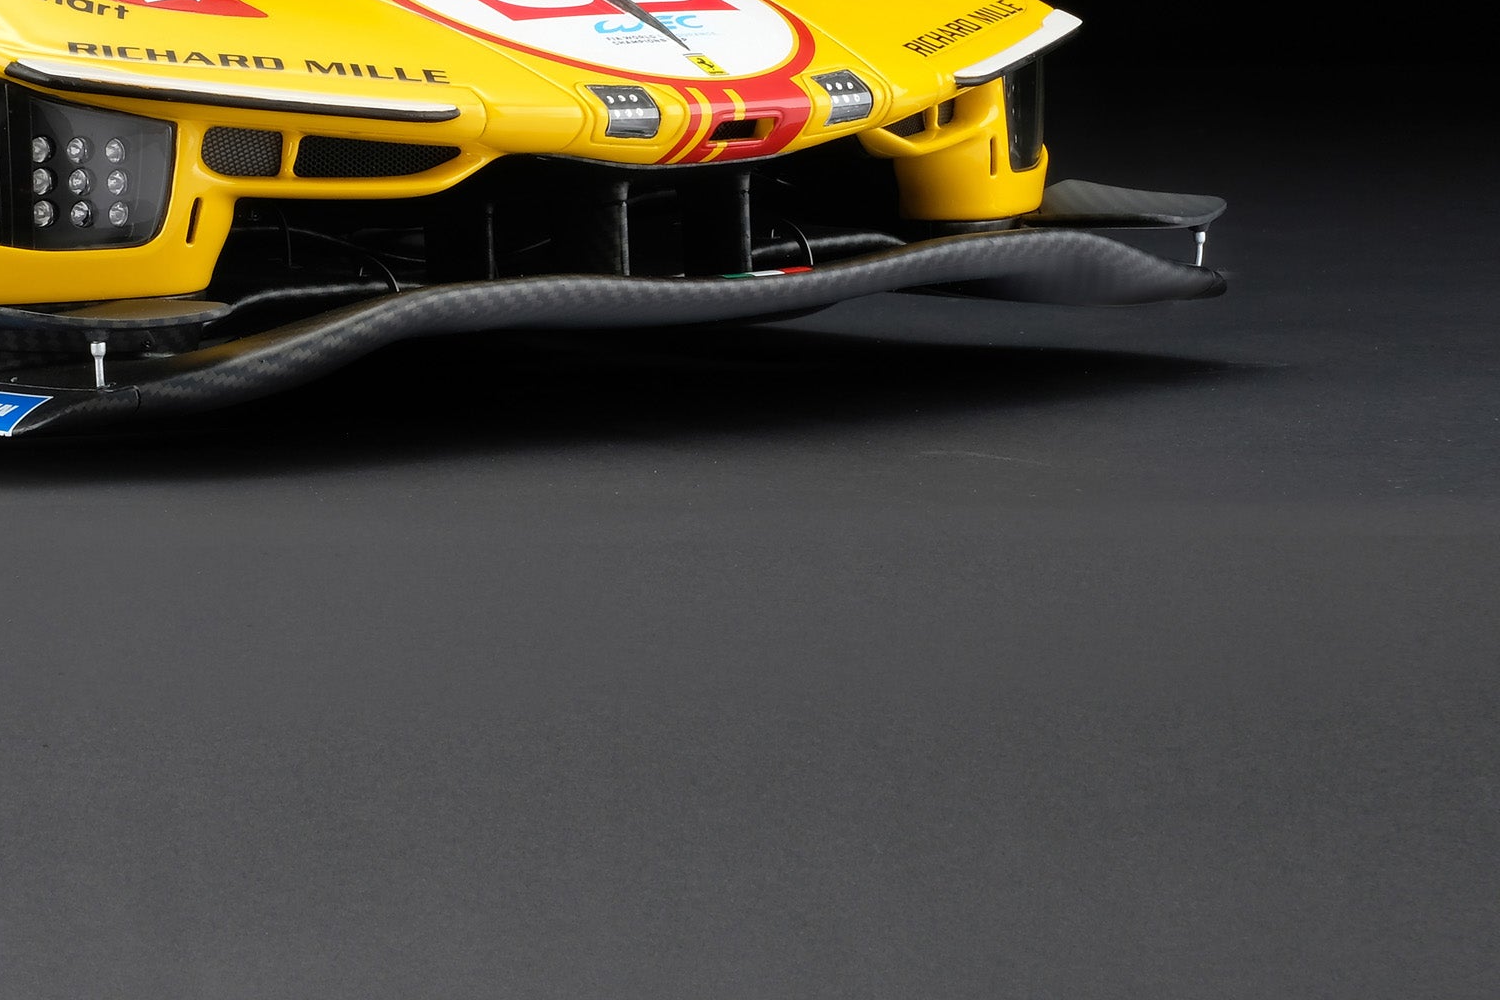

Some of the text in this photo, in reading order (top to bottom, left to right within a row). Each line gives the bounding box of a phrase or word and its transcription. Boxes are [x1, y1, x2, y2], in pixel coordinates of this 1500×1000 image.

[902, 0, 1023, 57] RICHARD MILLE
[67, 41, 450, 85] RICHARD MILLE
